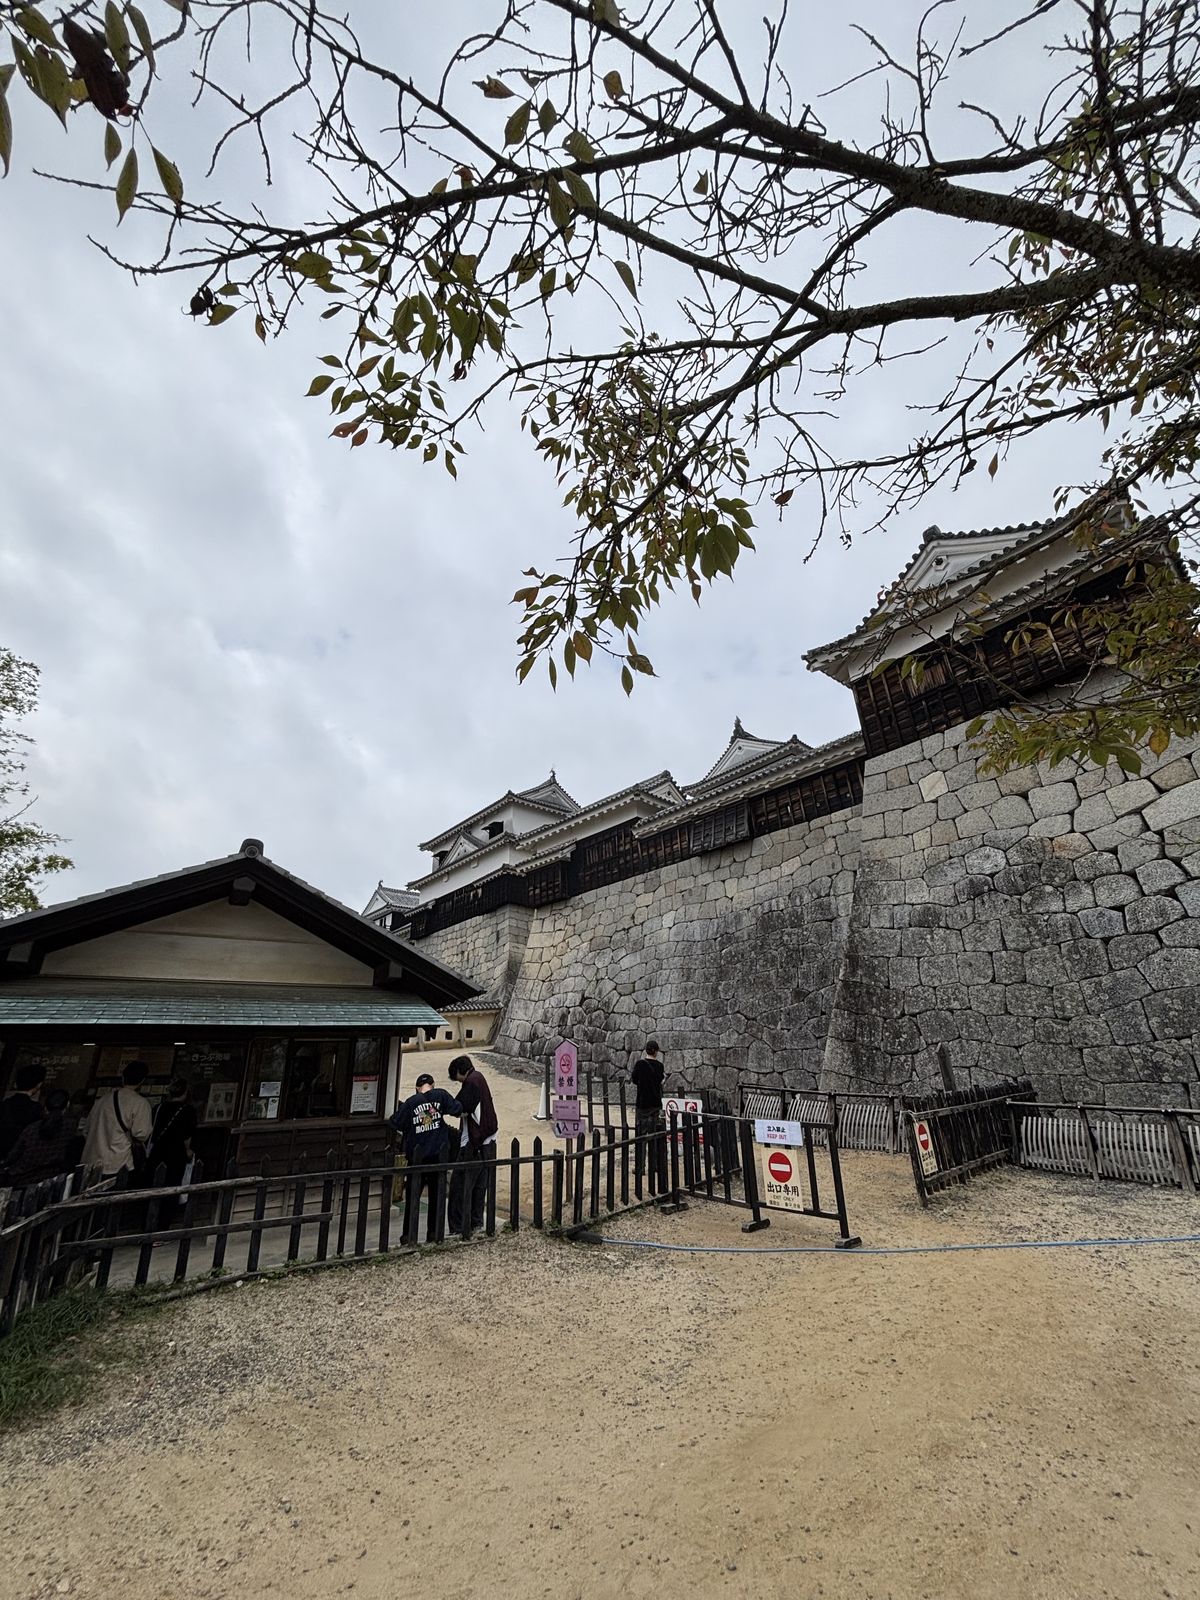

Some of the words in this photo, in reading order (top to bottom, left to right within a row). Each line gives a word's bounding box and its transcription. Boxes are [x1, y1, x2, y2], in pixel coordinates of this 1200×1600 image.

[558, 1076, 574, 1088] 禁煙
[562, 1122, 579, 1131] 入口
[767, 1125, 786, 1133] 立入禁止
[767, 1181, 800, 1197] 出口専用
